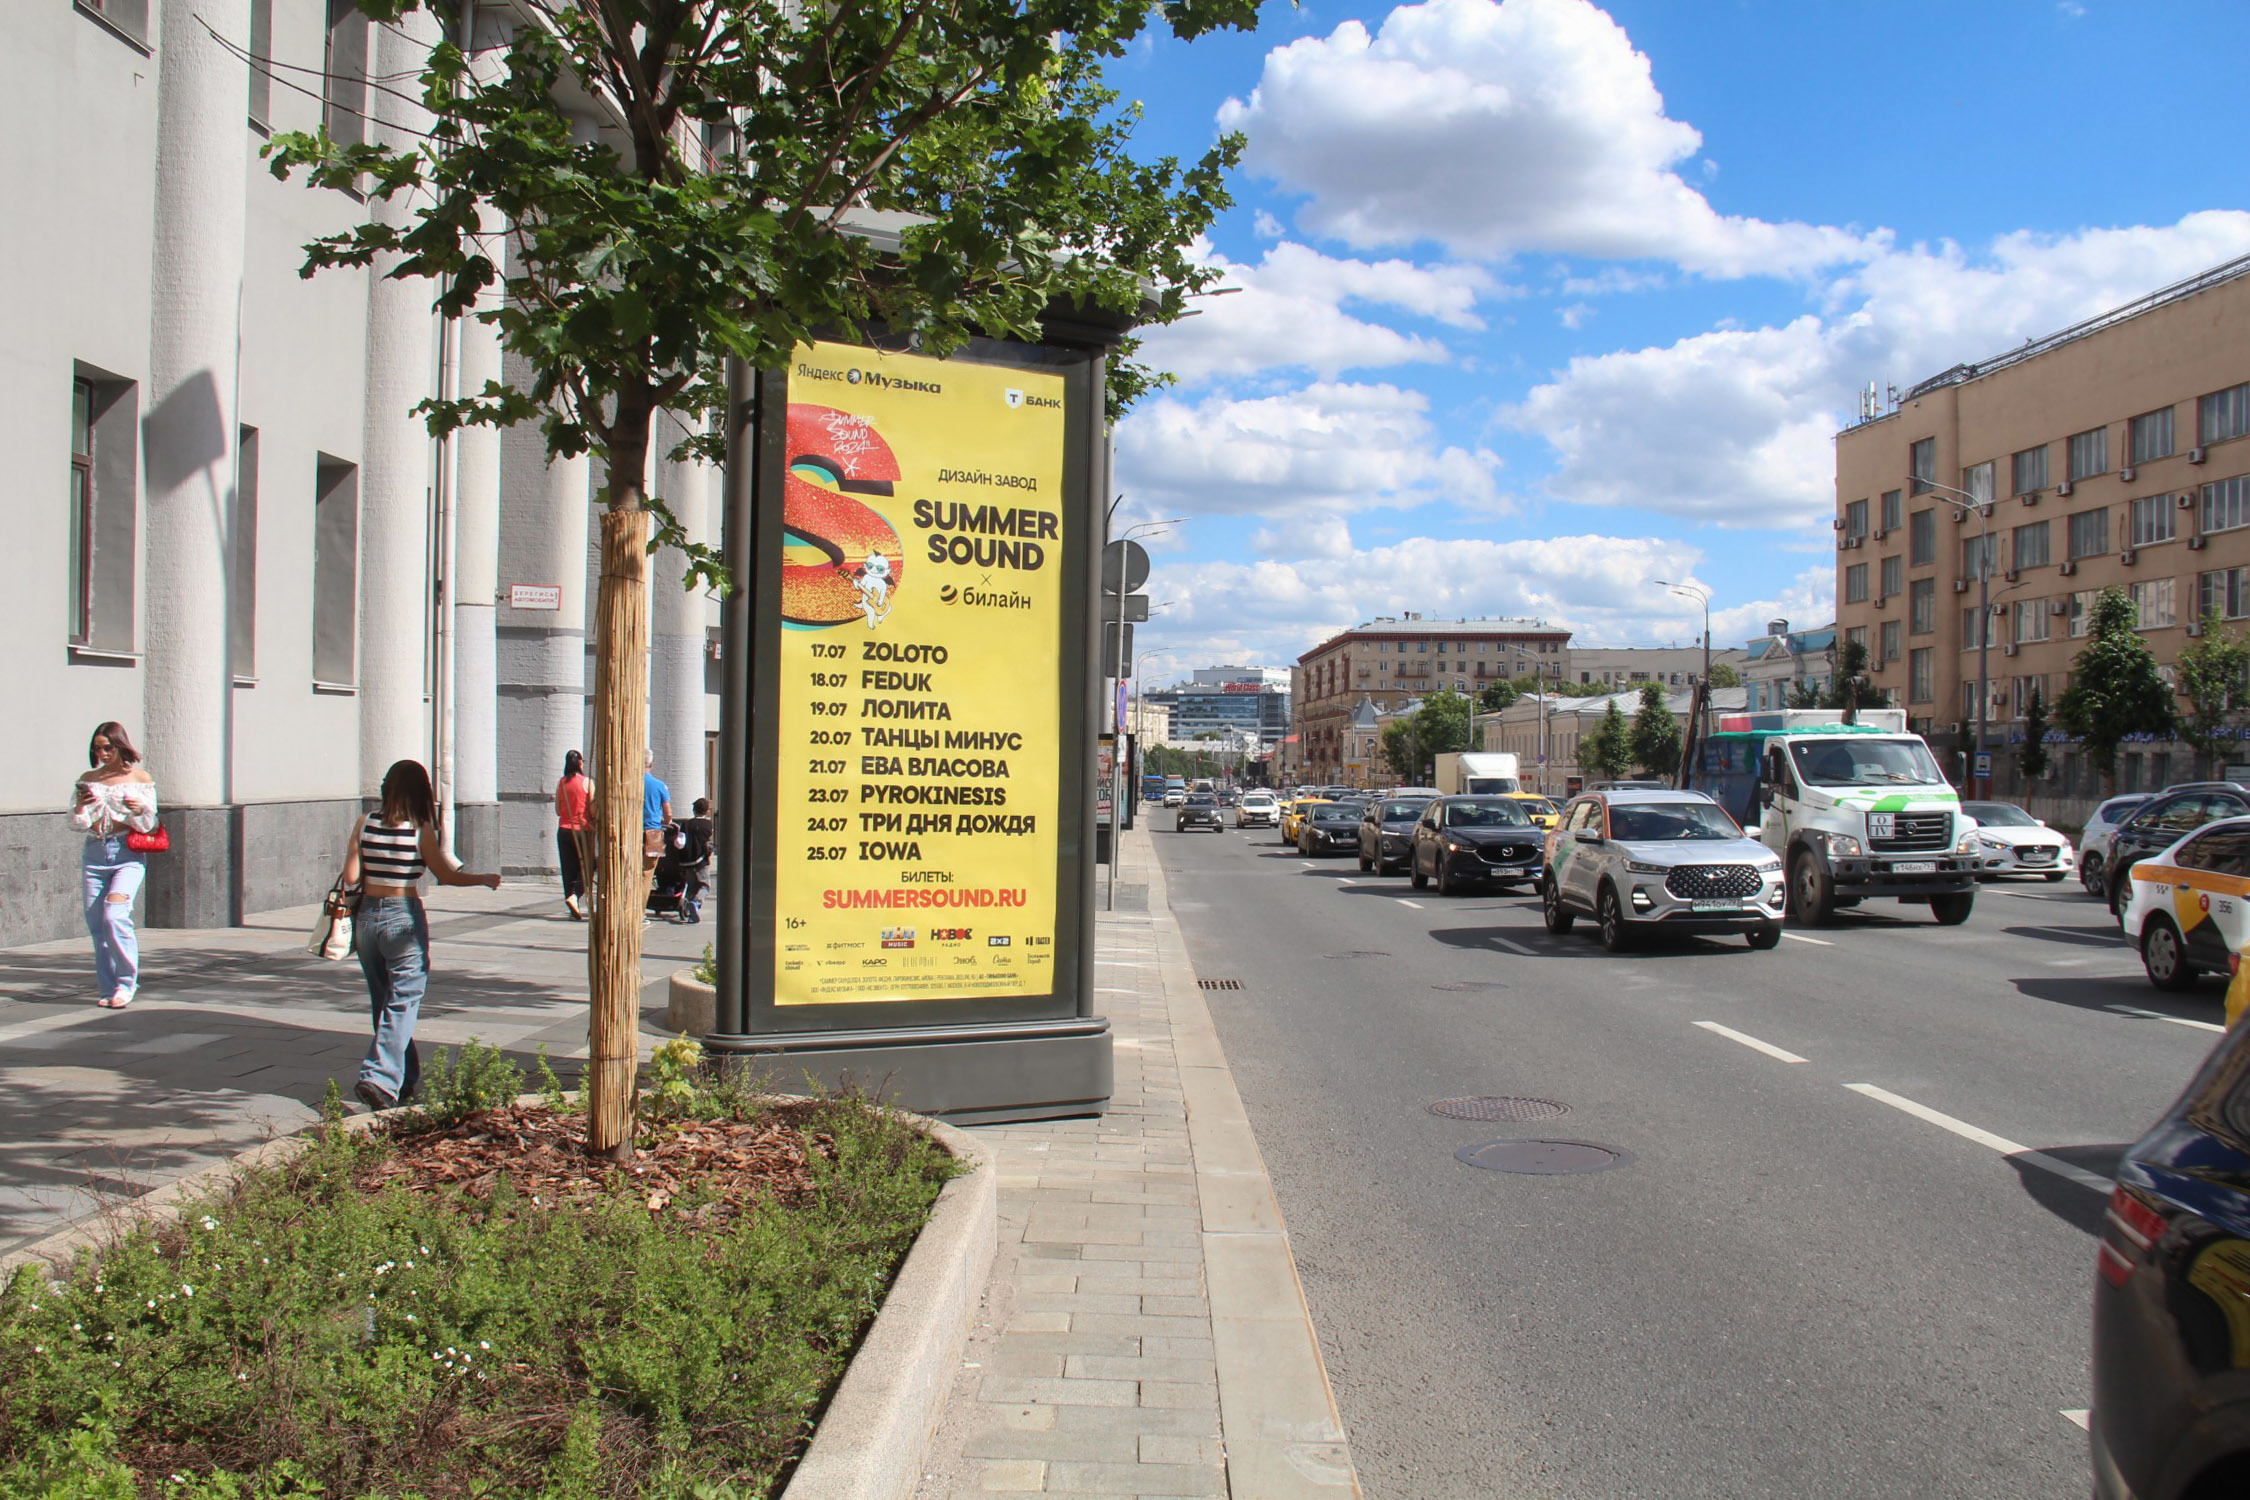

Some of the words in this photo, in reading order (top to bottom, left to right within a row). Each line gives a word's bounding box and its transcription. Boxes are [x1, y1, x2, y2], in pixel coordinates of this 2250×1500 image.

[798, 363, 844, 381] Яндекс
[864, 372, 942, 394] Музыка
[1025, 395, 1062, 409] БАНК
[938, 468, 993, 486] ДИЗАЙН
[994, 474, 1038, 491] ЗАВОД
[913, 499, 1059, 540] SUMMER
[927, 533, 1044, 571] SOUND
[963, 587, 1032, 609] билайн
[810, 643, 847, 659] 17.07
[862, 641, 949, 665] ZOLOTO
[810, 672, 848, 688] 18.07
[861, 670, 932, 692] FEDUK
[810, 701, 848, 717] 19.07
[861, 698, 952, 721] ЛОЛИТА
[809, 730, 852, 746] 20.07
[861, 727, 939, 751] ТАНЦЫ
[944, 731, 1023, 751] МИНУС
[808, 759, 847, 774] 21.07
[861, 756, 904, 776] ЕВА
[908, 757, 1010, 778] ВЛАСОВА
[808, 788, 849, 803] 23.07
[860, 784, 1007, 806] PYROKINESIS
[807, 817, 848, 832] 24.07
[859, 813, 902, 833] ТРИ
[906, 814, 952, 836] ДНЯ
[956, 814, 1036, 836] ДОЖДЯ
[807, 846, 847, 861] 25.07
[859, 841, 922, 861] IOWA
[901, 871, 955, 883] БИЛЕТЫ:
[823, 889, 1026, 909] SUMMERSOUND.RU
[2217, 899, 2233, 914] 356
[785, 917, 807, 929] 16+
